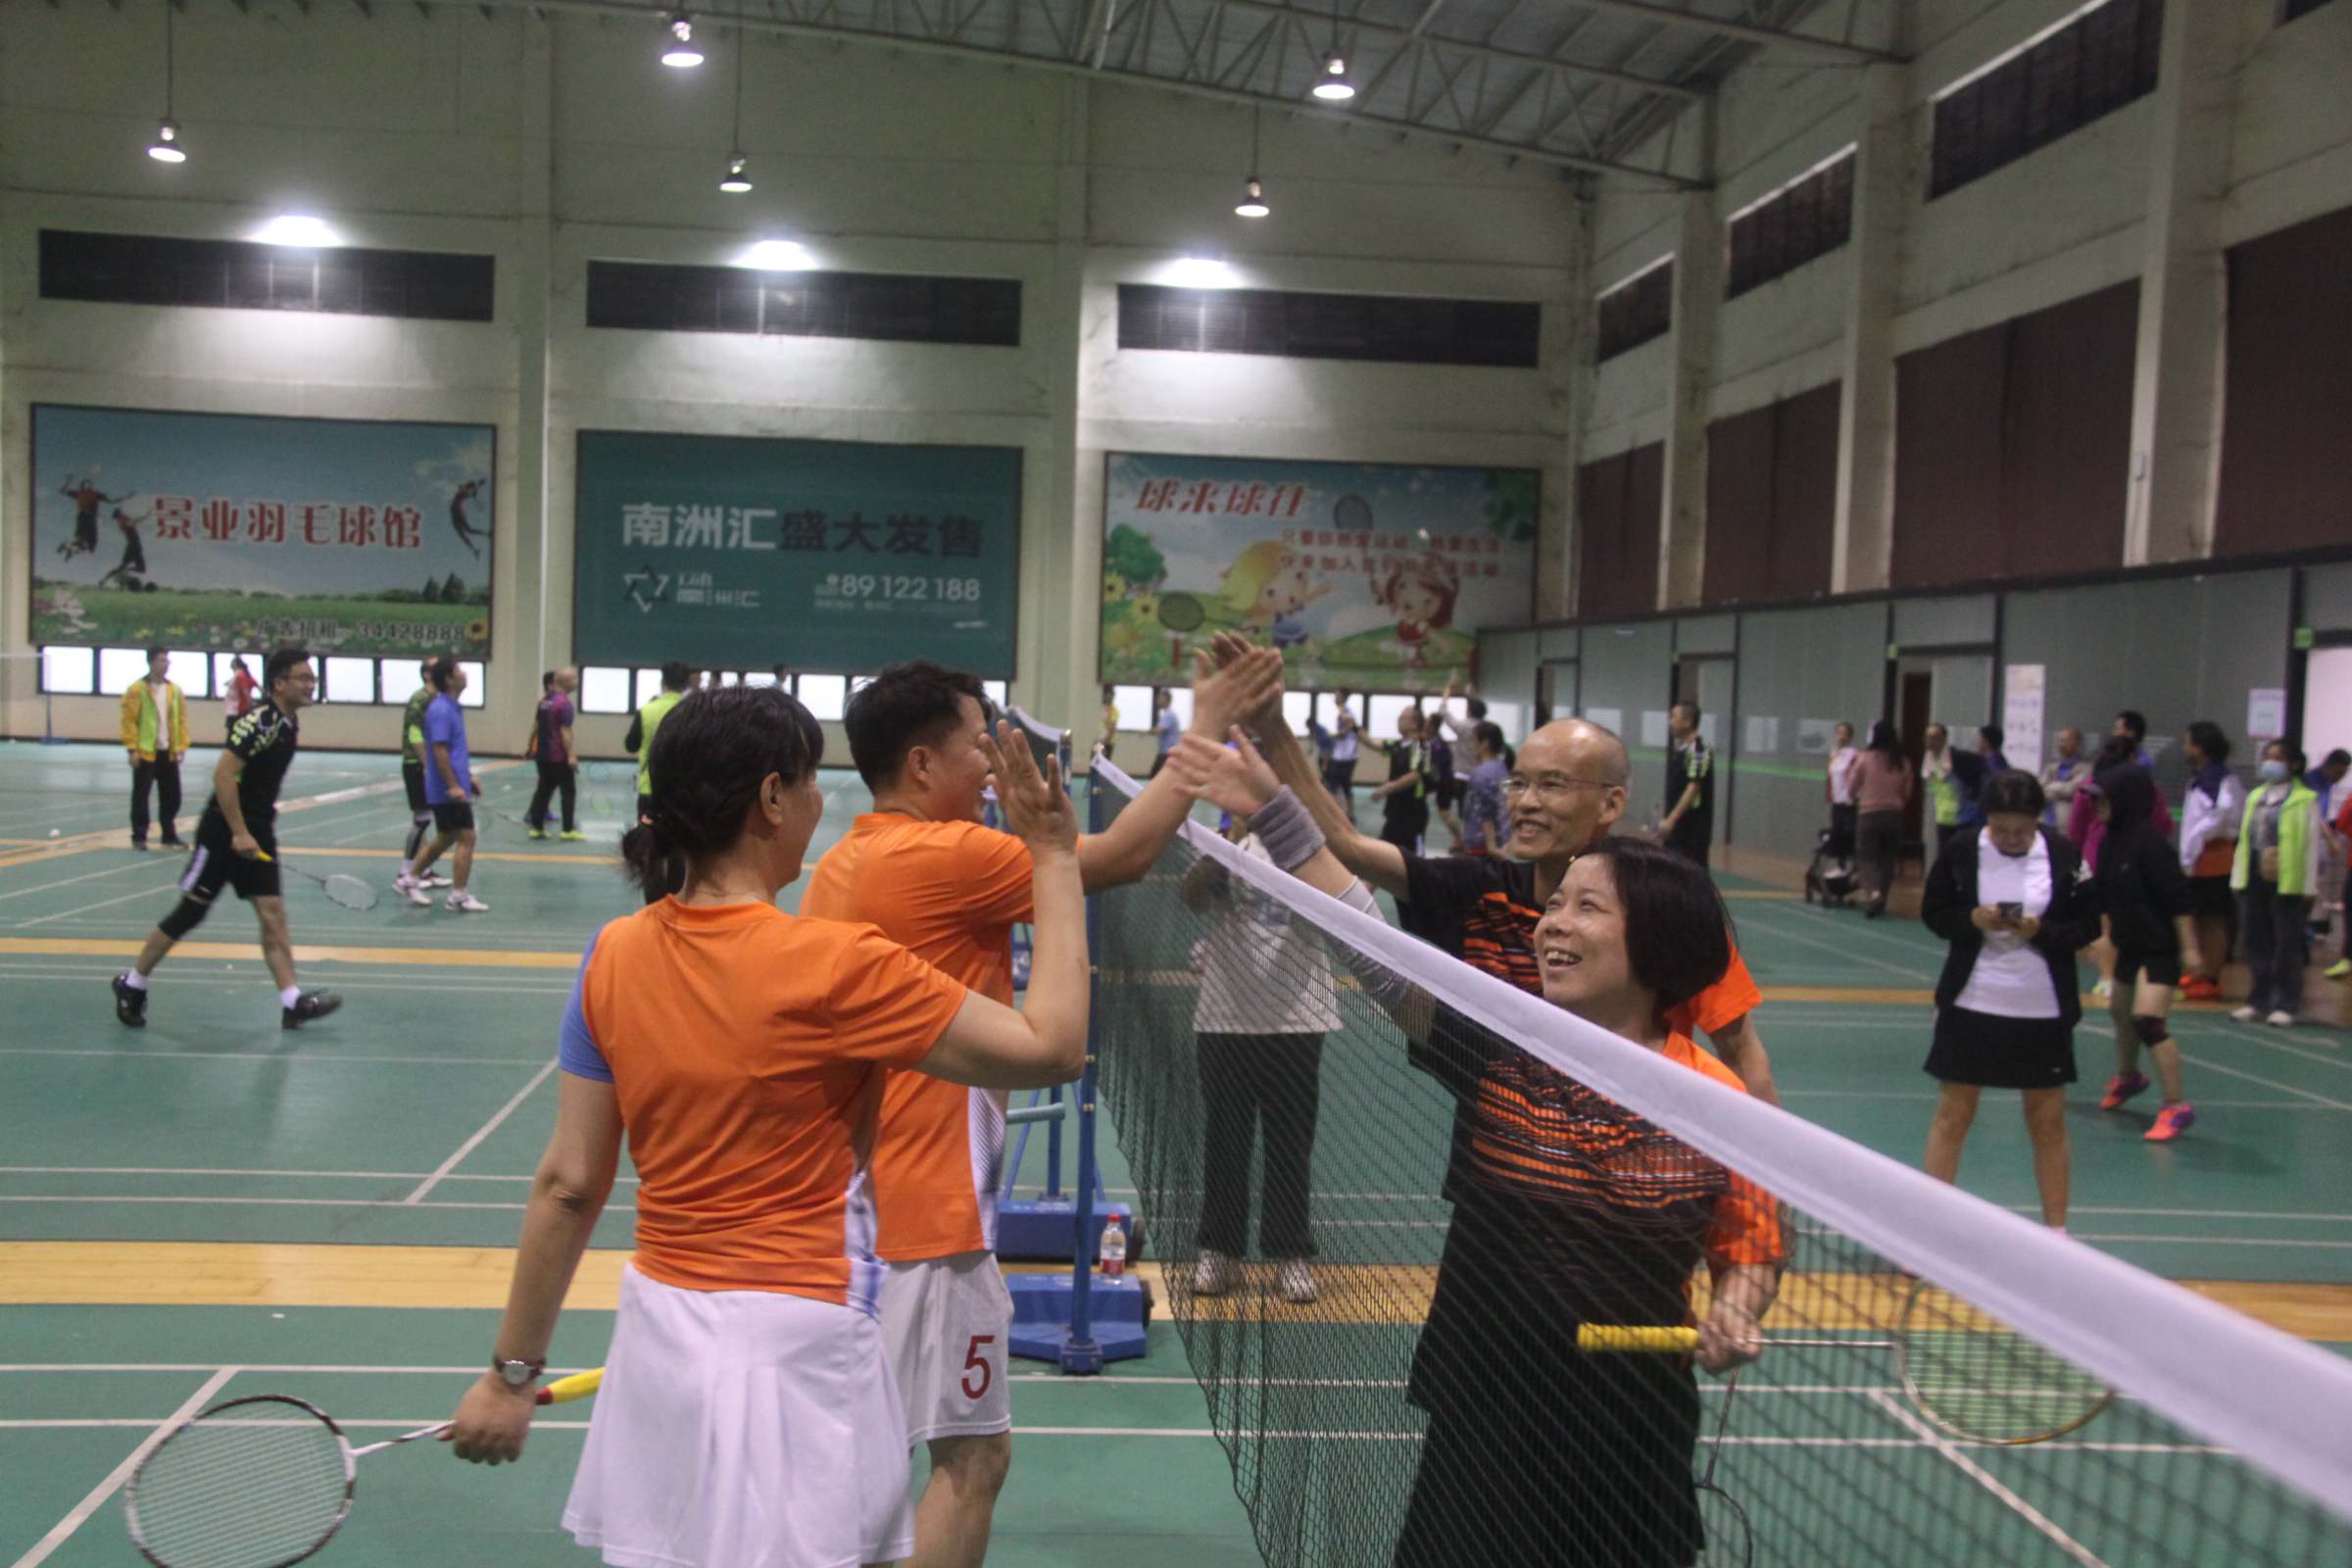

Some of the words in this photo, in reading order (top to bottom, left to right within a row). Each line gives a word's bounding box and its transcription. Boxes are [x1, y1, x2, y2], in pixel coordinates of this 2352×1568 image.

[155, 497, 421, 548] 景业羽毛球馆
[961, 1335, 996, 1399] 5
